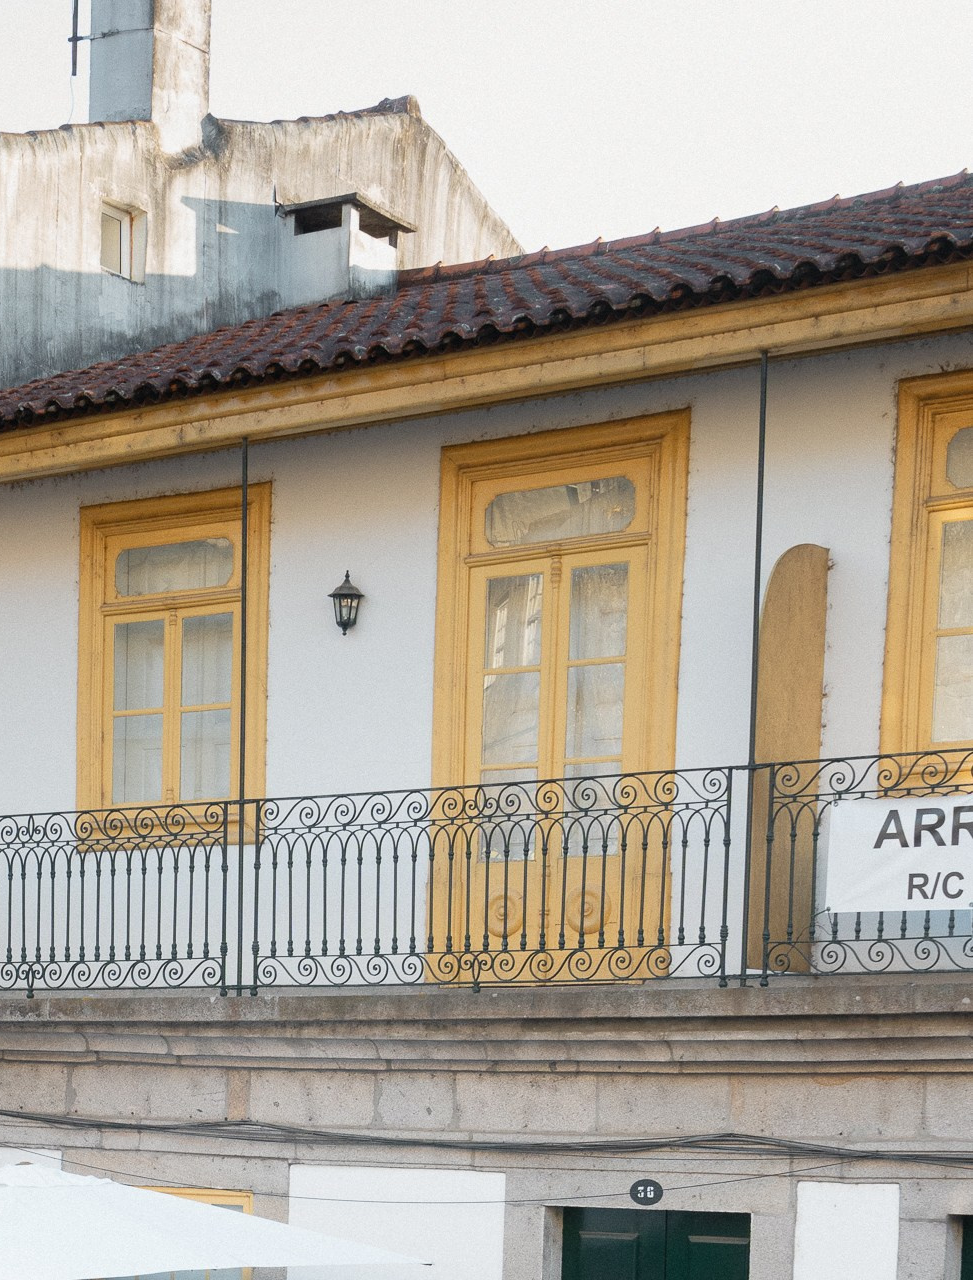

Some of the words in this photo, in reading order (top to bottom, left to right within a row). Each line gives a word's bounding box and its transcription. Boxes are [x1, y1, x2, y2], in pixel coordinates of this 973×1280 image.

[873, 805, 973, 849] ARR
[907, 871, 965, 900] R/C
[637, 1186, 655, 1198] 36
